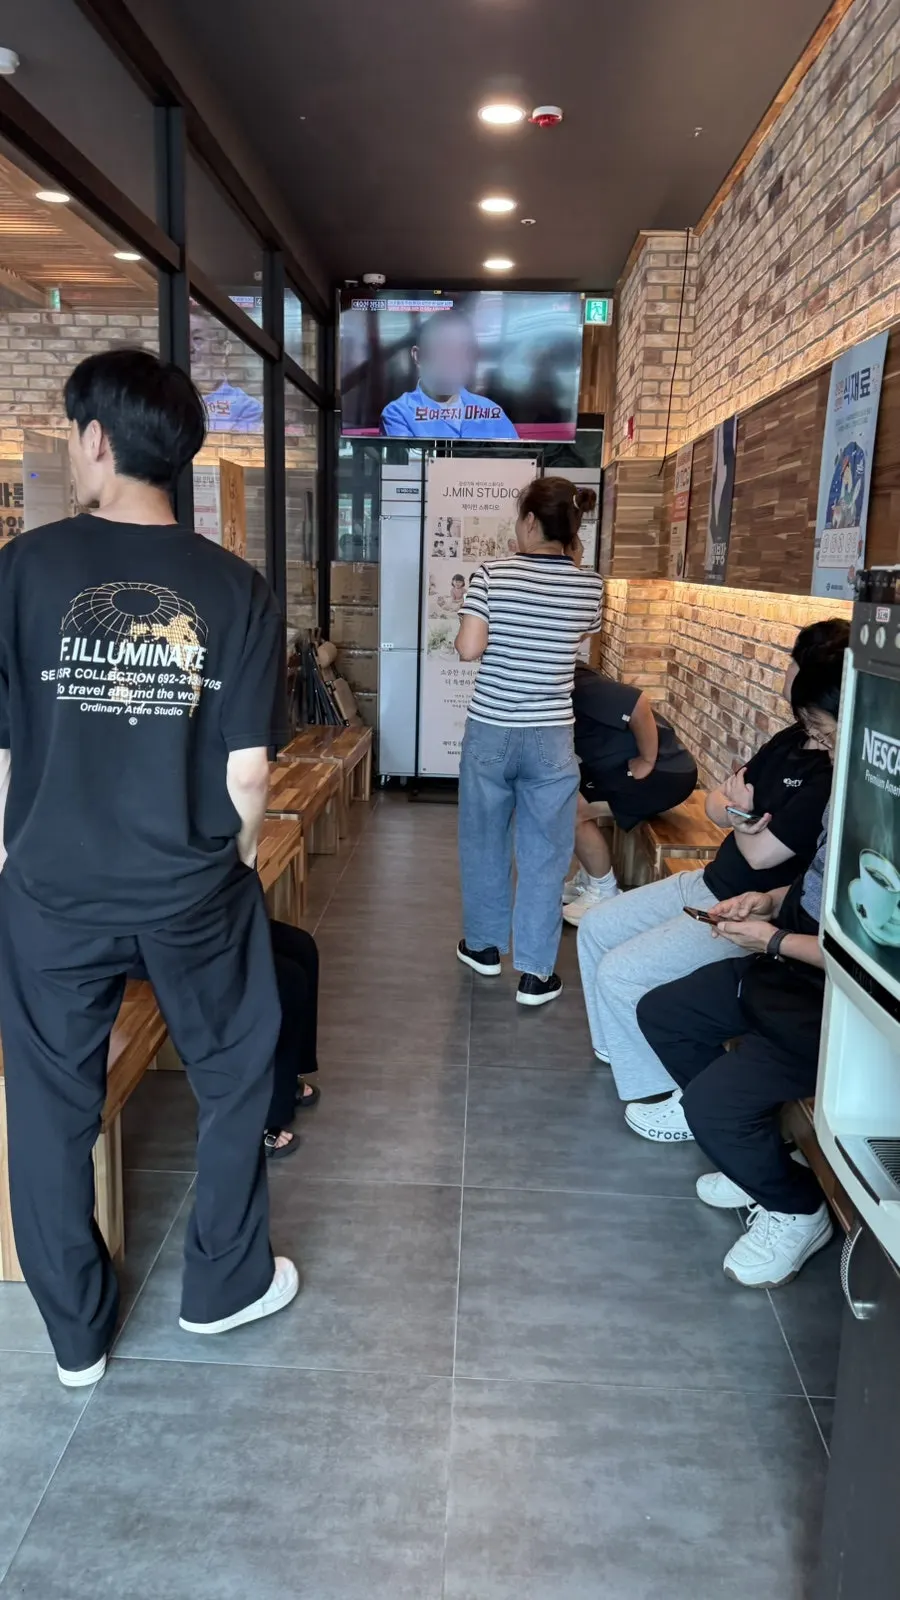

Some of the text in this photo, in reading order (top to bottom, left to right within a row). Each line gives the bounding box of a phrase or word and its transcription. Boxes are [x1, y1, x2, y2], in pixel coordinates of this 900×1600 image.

[843, 367, 871, 405] 식재료
[414, 404, 501, 421] 보여주지 마세요
[442, 487, 520, 499] J.MIN STUDIO
[74, 668, 155, 684] COLLECTION
[68, 683, 105, 696] travel
[156, 687, 174, 699] the
[80, 702, 184, 716] Ordinary Attire Studio
[648, 1128, 688, 1140] crocs
